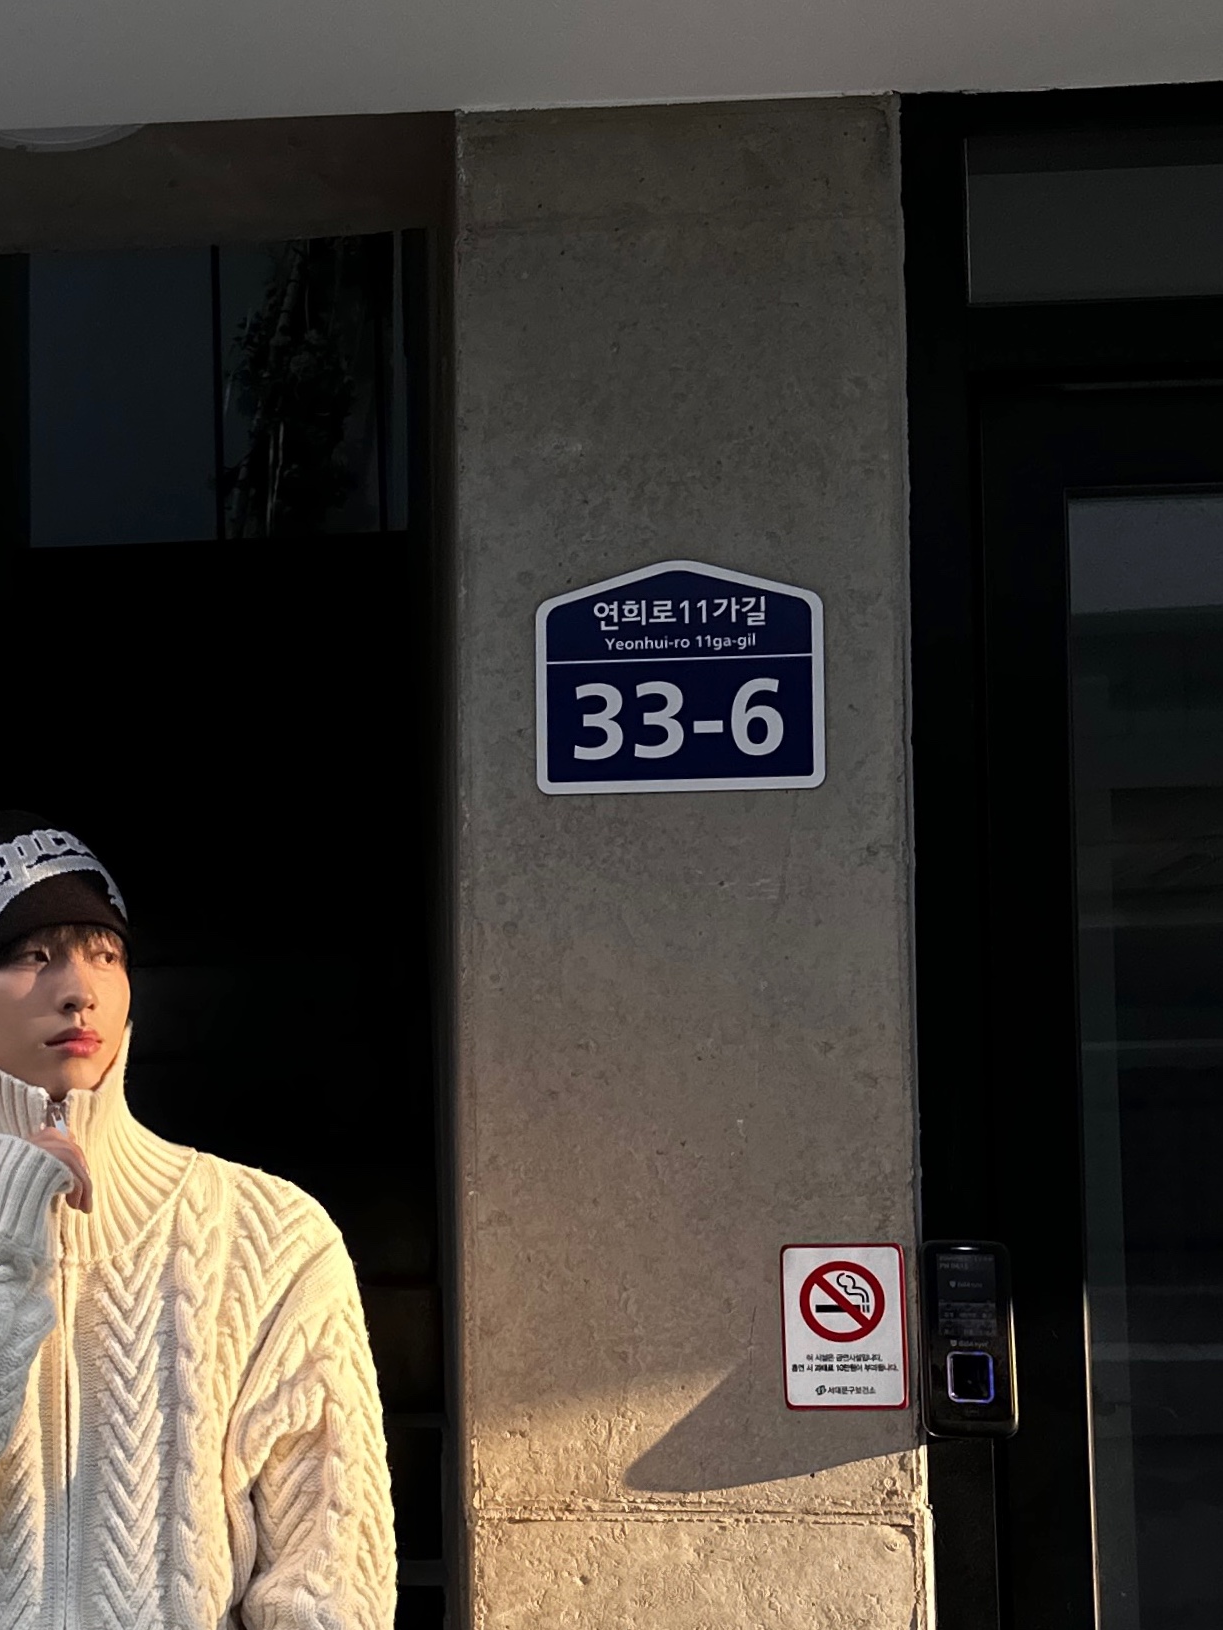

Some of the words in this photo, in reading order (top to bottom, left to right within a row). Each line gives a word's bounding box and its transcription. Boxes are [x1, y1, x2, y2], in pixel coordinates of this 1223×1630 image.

[593, 596, 767, 631] 연희로11가길
[604, 635, 691, 651] Yeonhui-ro
[695, 633, 757, 649] 11ga-gil
[573, 677, 784, 761] 33-6
